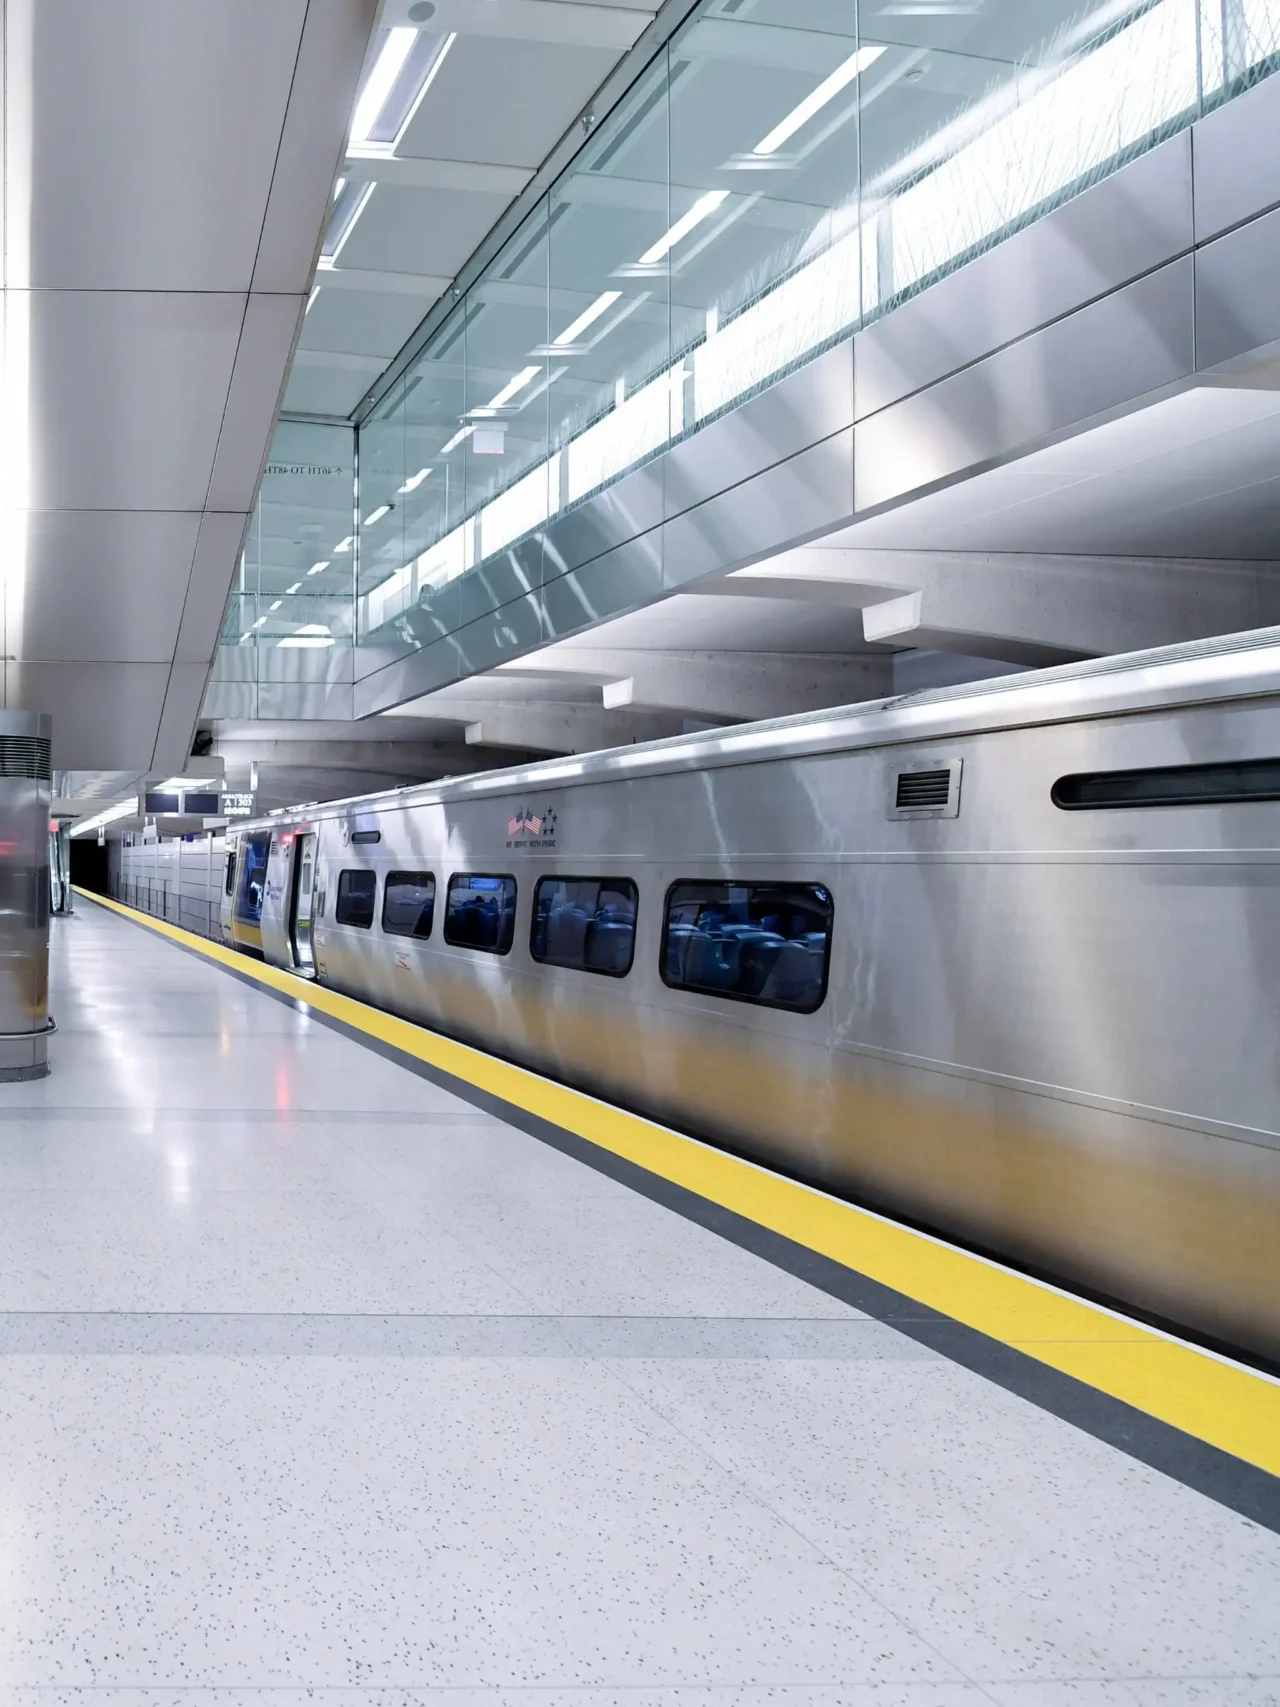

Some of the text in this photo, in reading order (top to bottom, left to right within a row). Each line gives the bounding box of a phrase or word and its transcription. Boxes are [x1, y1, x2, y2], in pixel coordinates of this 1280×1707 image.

[238, 798, 252, 806] 303
[514, 840, 528, 848] SERVE
[530, 840, 541, 848] WITH
[542, 839, 556, 847] PRIDE
